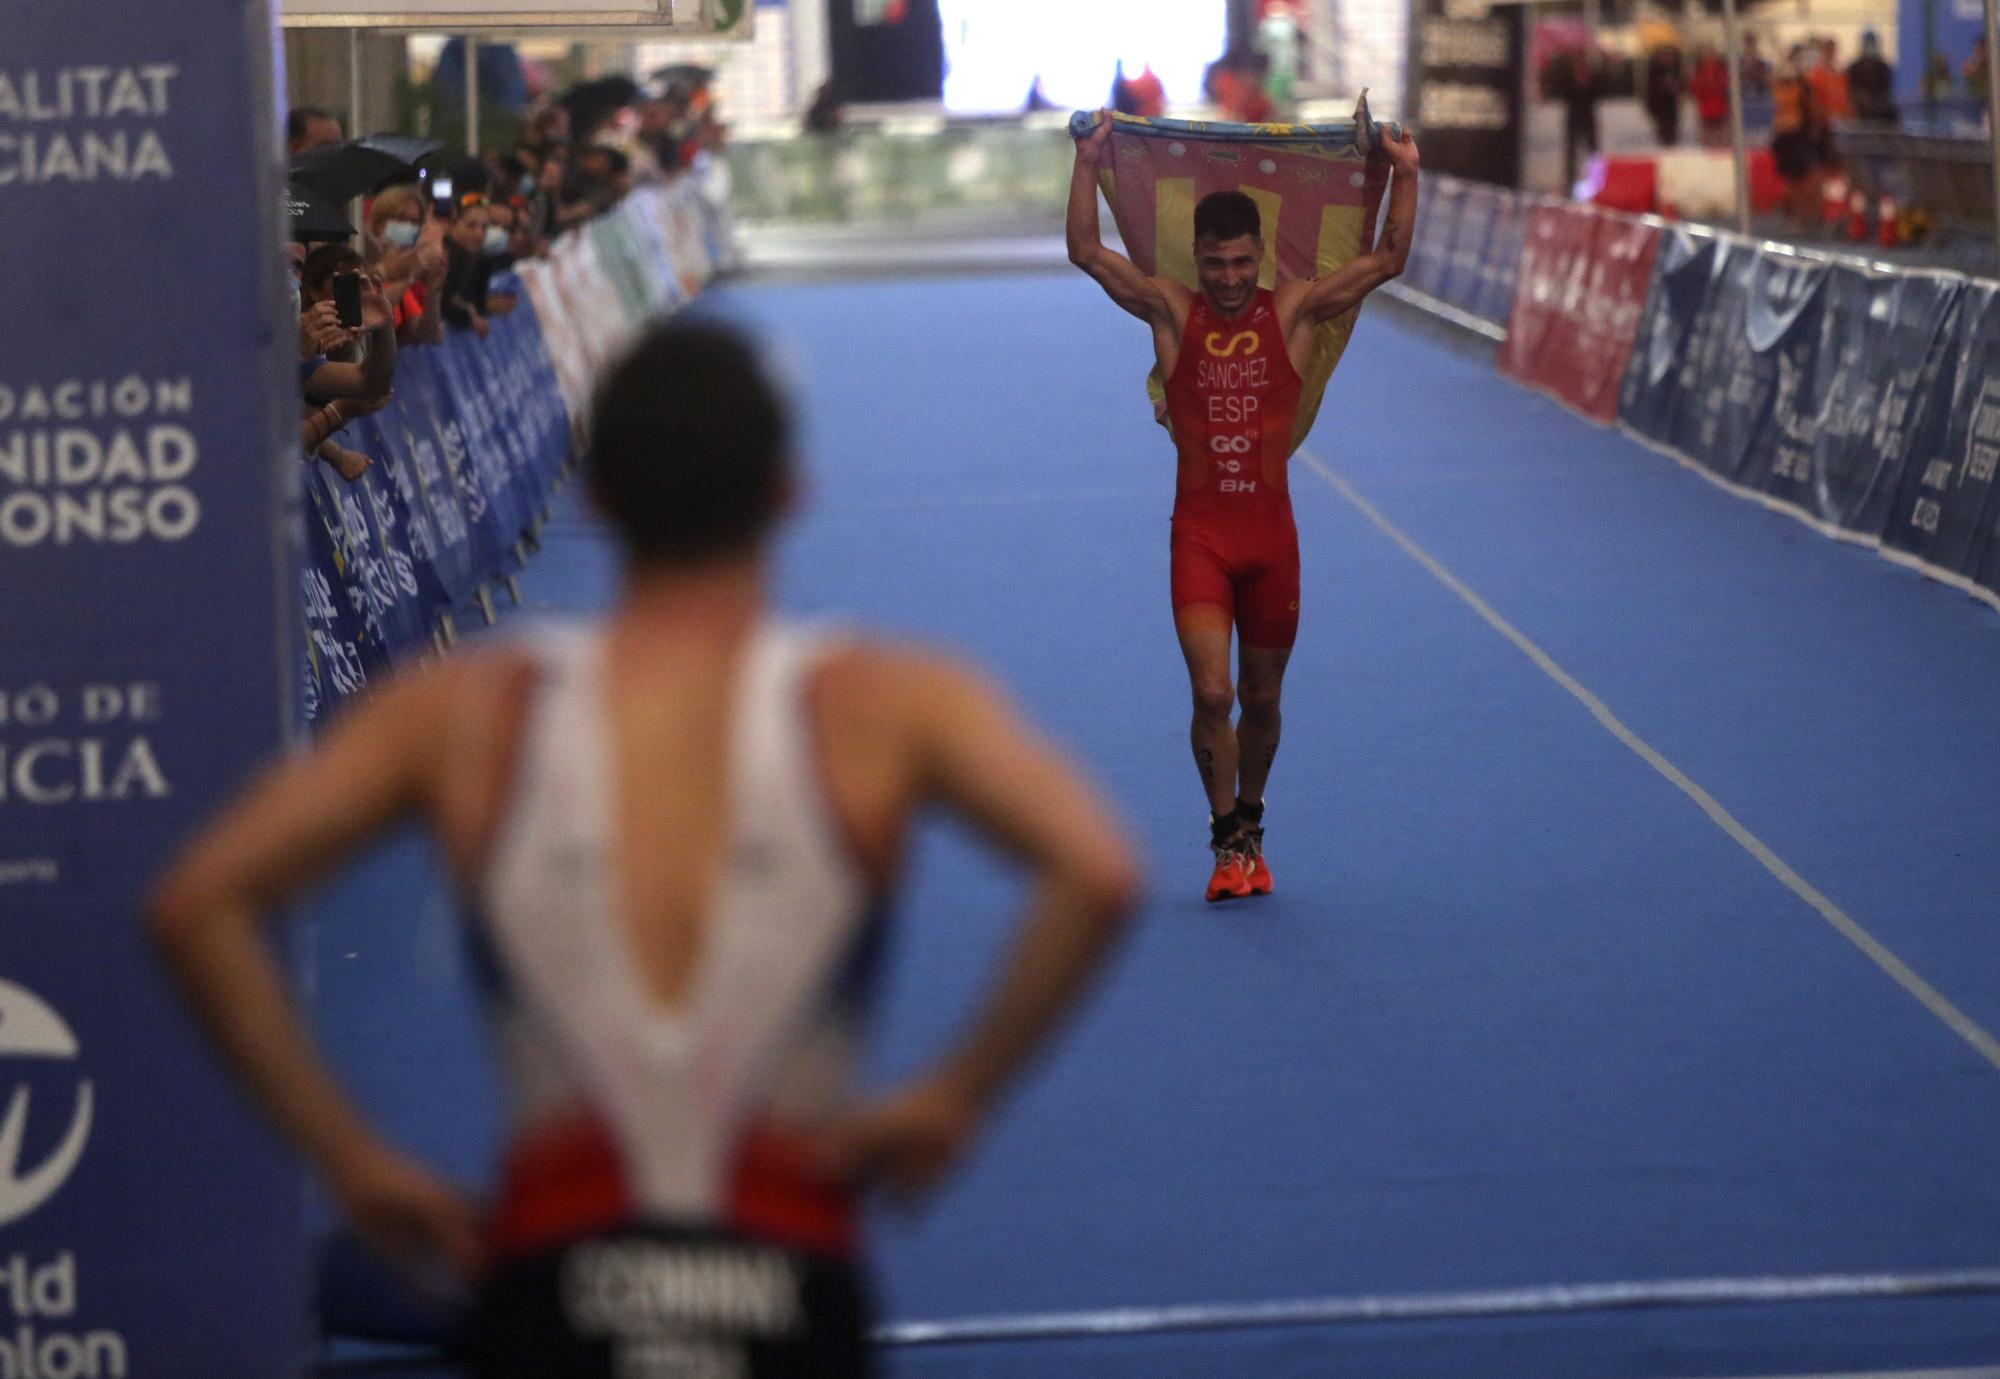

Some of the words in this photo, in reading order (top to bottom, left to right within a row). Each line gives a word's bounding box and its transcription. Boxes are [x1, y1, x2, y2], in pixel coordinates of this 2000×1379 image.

[1197, 357, 1270, 389] SANCHEZ
[1208, 395, 1258, 423] ESP
[1210, 434, 1252, 454] GO
[1219, 479, 1257, 493] BH
[83, 680, 162, 723] DE
